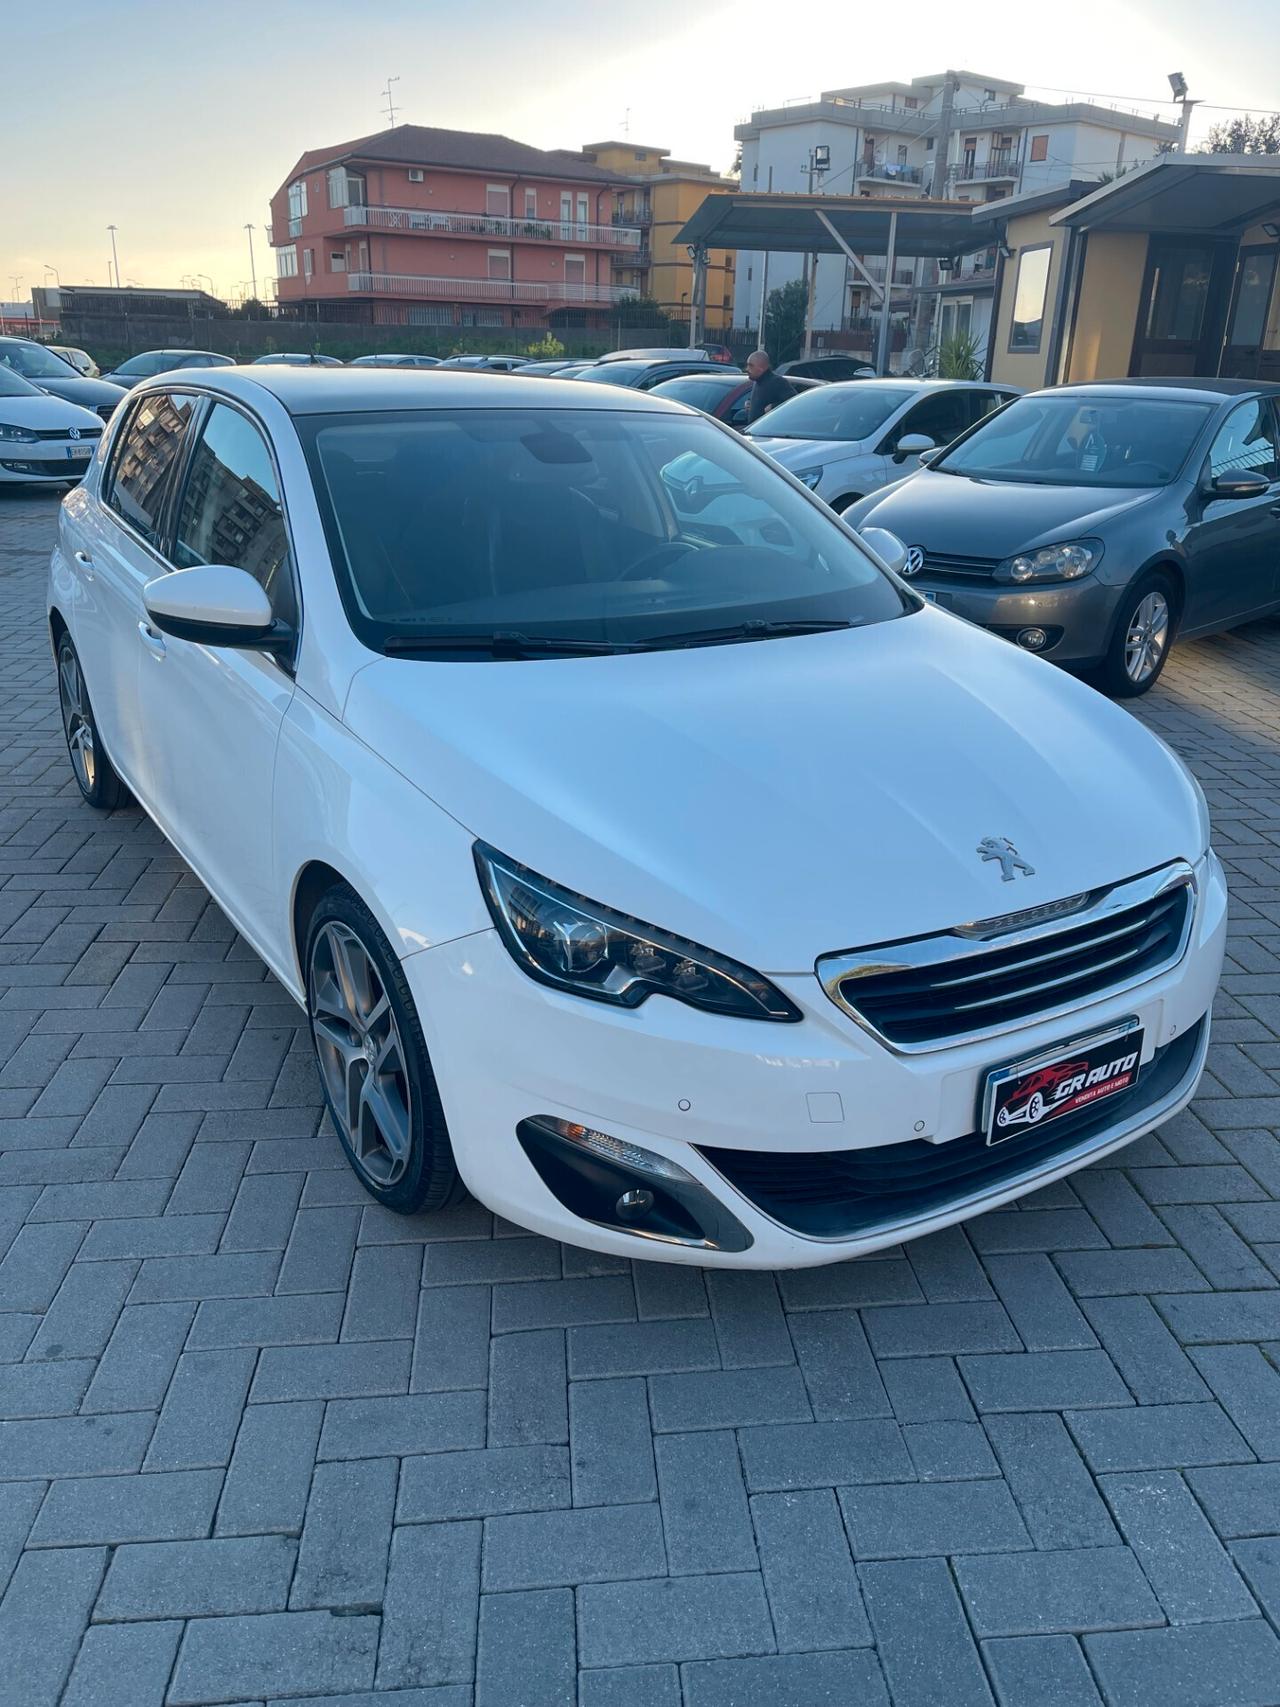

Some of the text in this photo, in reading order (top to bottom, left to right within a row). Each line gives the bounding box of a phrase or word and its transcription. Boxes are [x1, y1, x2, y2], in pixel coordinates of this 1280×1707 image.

[994, 899, 1073, 927] PEUGEOT
[1054, 1051, 1138, 1100] GR AUTO
[1097, 1084, 1111, 1095] AUTO
[1114, 1076, 1129, 1087] MOTO
